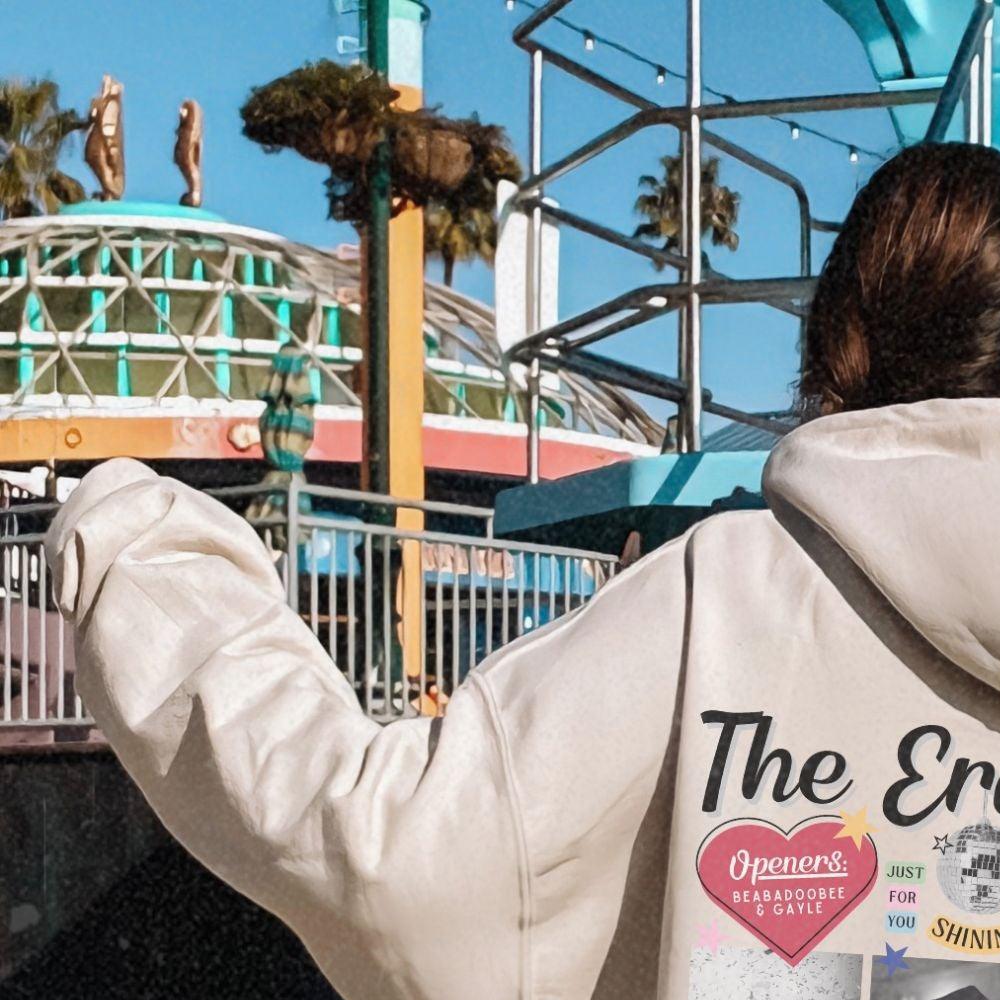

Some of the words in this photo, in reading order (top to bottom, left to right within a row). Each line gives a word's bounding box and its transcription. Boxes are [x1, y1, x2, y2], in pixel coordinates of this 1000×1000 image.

[700, 710, 854, 813] The
[729, 849, 849, 886] Openers:
[886, 865, 925, 880] JUST
[732, 886, 845, 903] BEABADOOBEE
[889, 890, 916, 904] FOR
[756, 903, 764, 917] &
[773, 901, 823, 915] GAYLE
[888, 915, 916, 929] YOU
